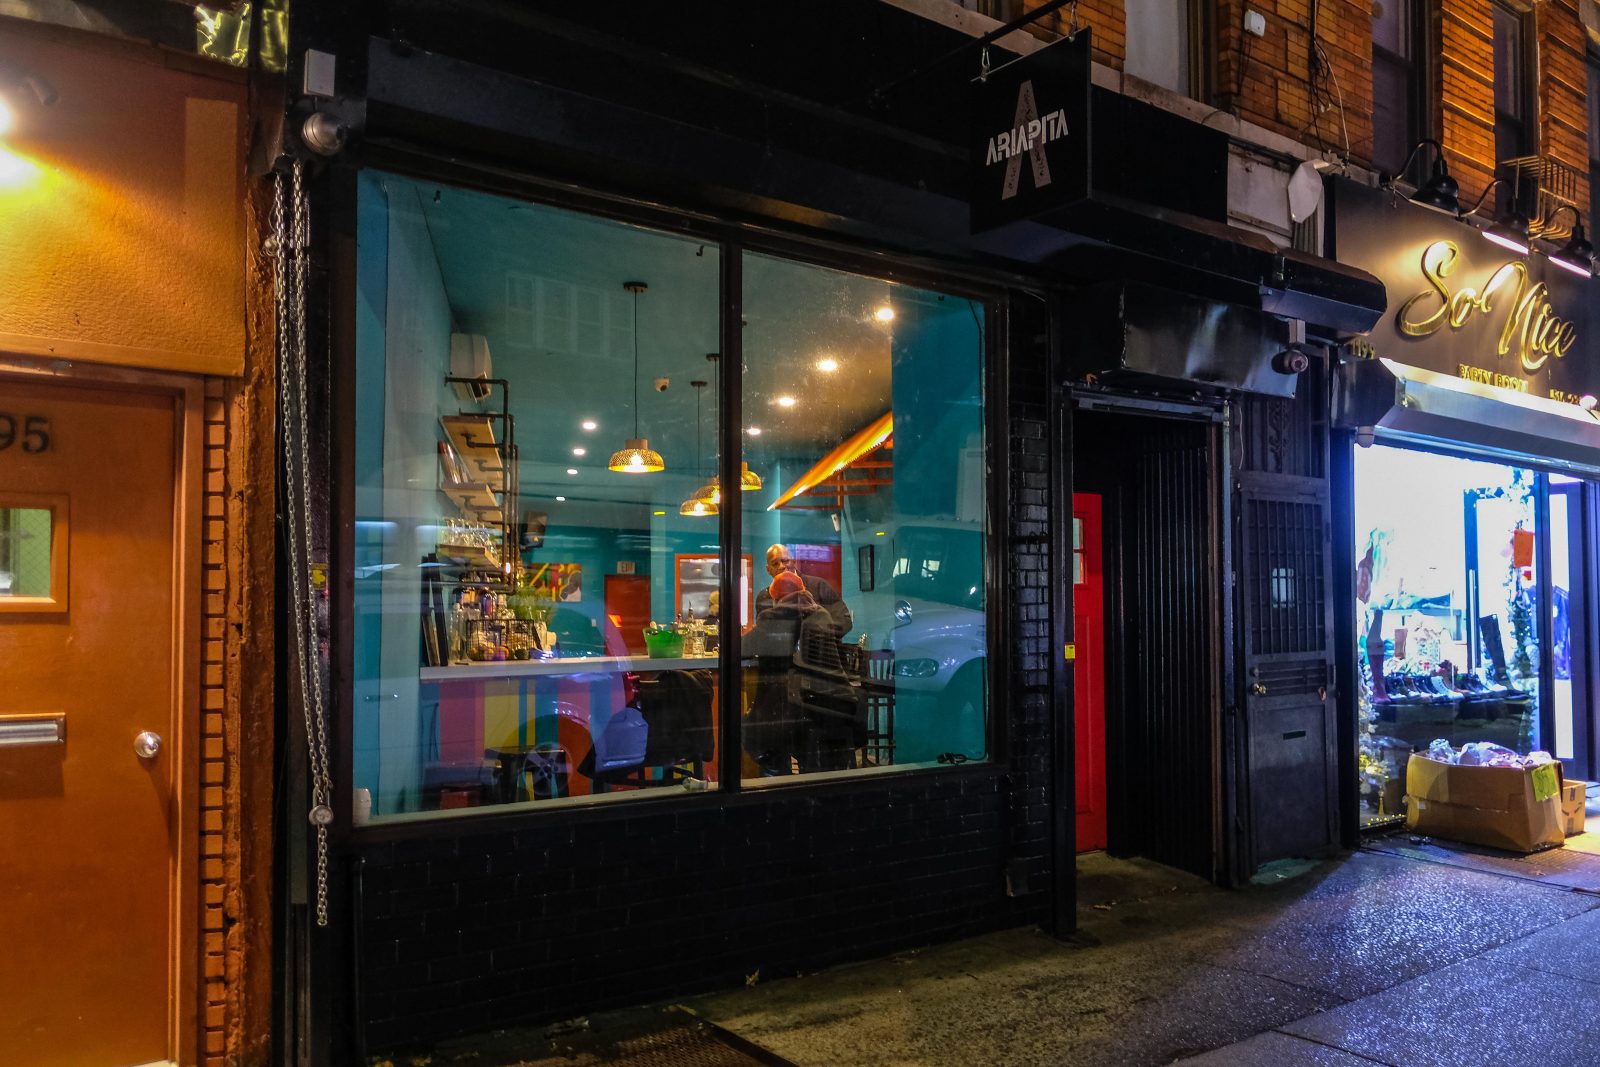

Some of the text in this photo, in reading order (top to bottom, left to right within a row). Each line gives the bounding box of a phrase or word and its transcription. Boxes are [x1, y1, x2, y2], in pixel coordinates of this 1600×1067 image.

[986, 109, 1069, 166] ARIAPITA
[1401, 240, 1577, 370] So Nice
[1459, 363, 1529, 394] PARTY ROOM
